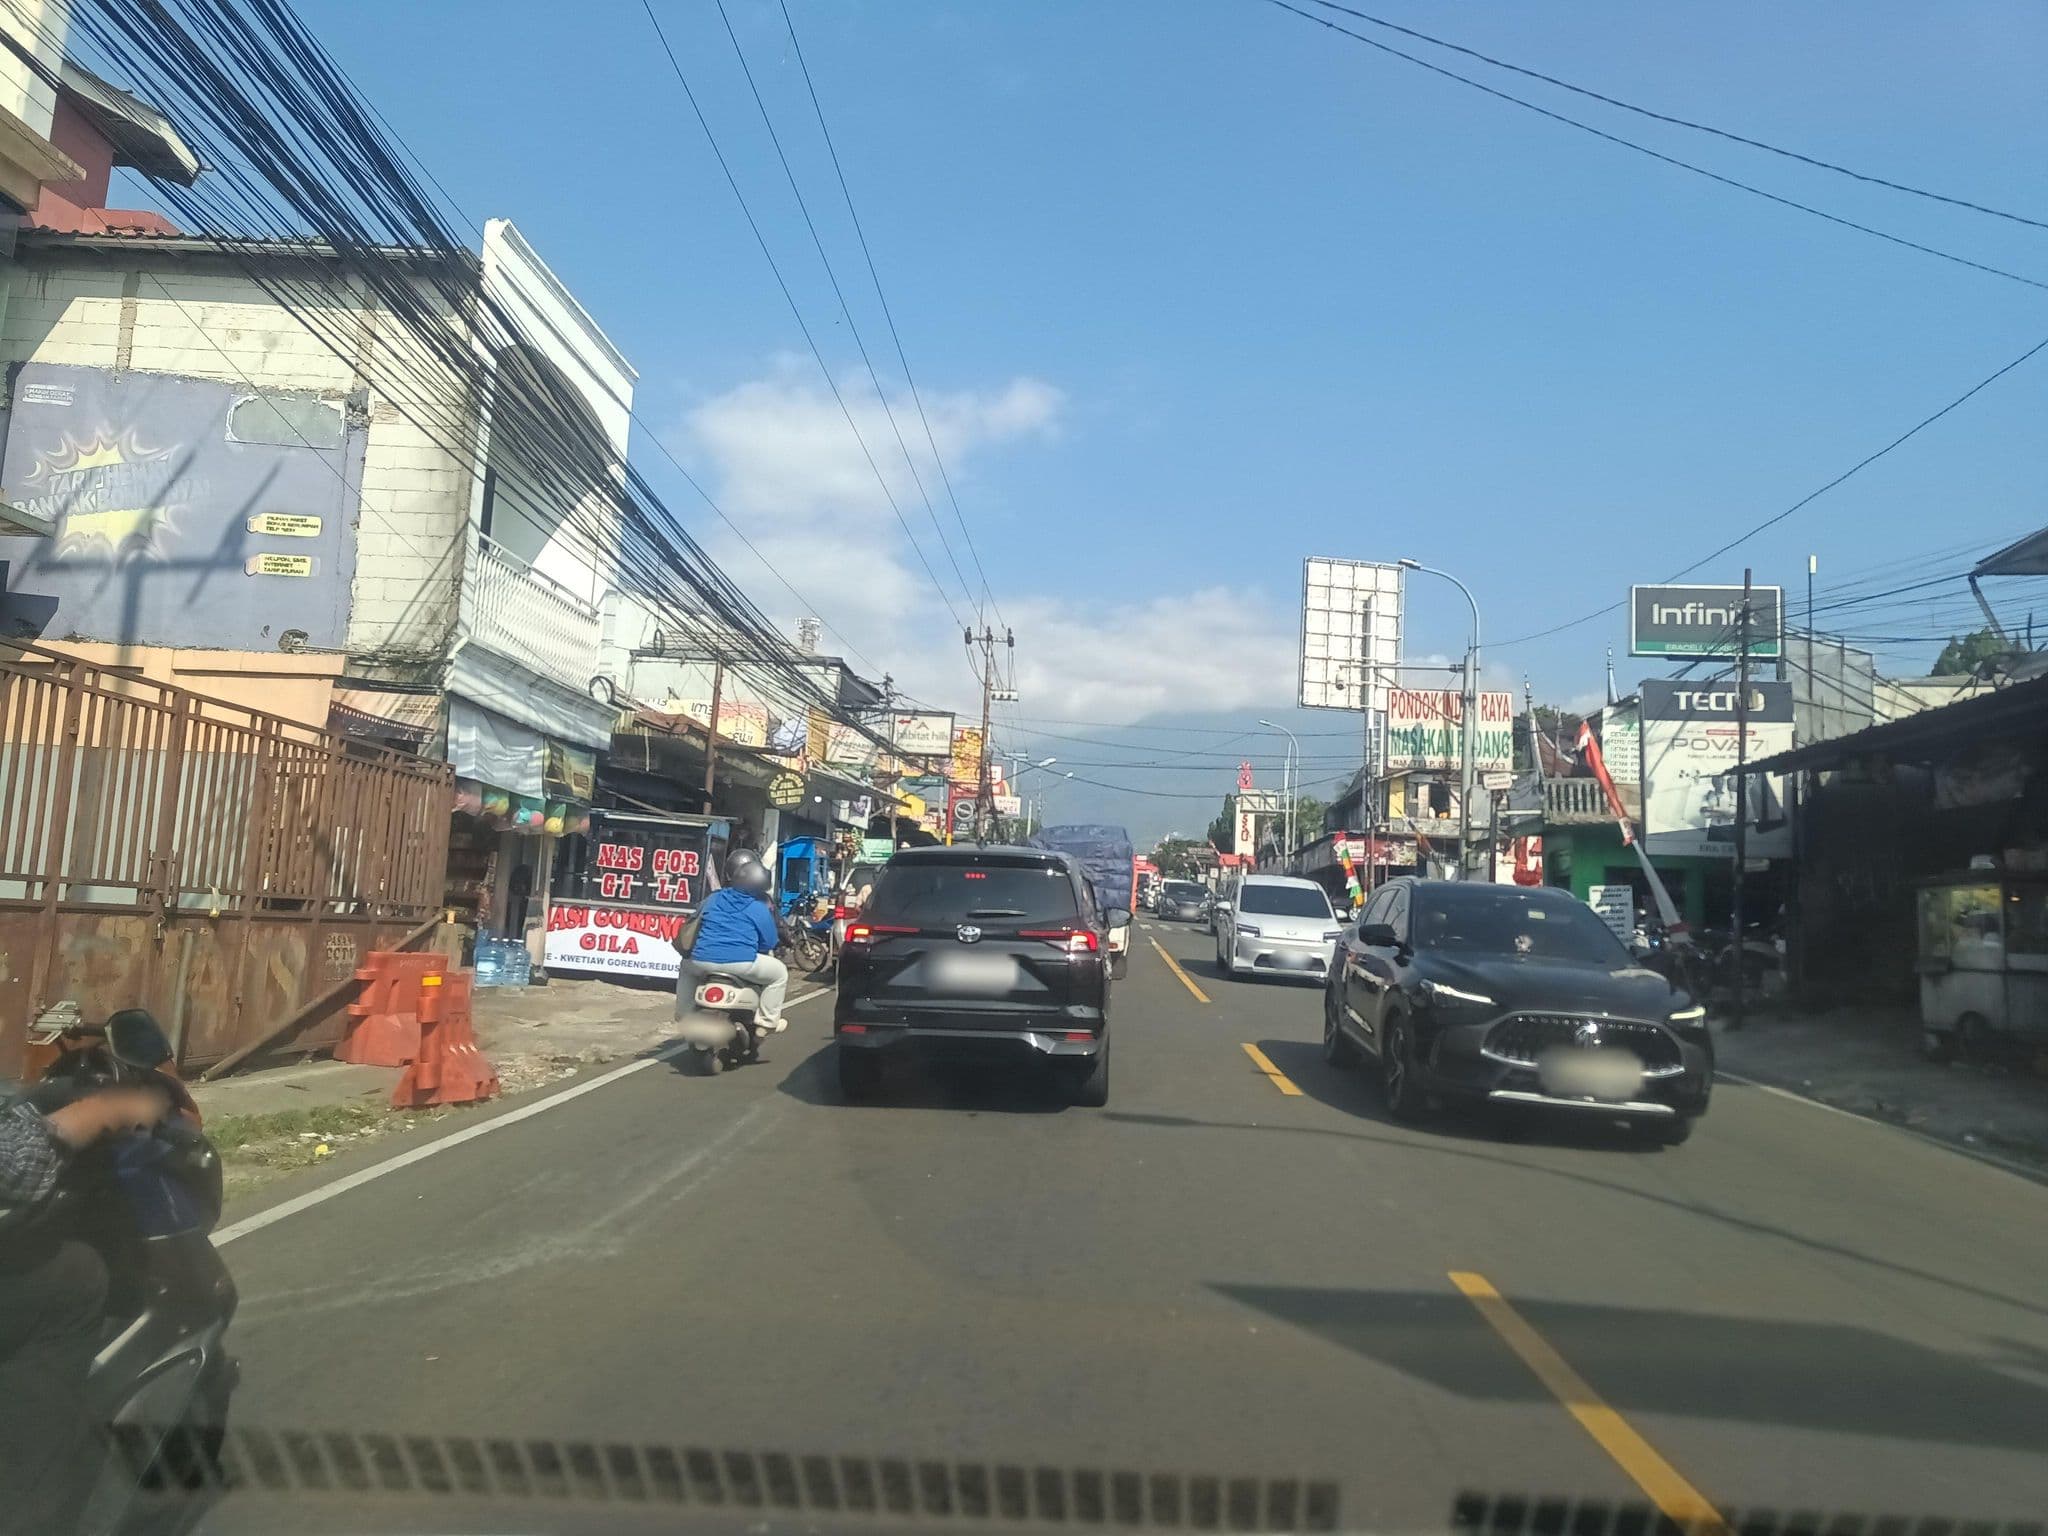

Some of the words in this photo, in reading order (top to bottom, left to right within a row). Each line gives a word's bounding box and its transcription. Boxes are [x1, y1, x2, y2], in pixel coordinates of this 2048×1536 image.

[1391, 691, 1440, 721] PONDOK
[1480, 693, 1511, 722] RAYA
[1391, 727, 1455, 757] MASAKAN
[597, 844, 644, 871] NAS
[653, 849, 699, 876] GOR
[580, 933, 639, 954] GILA
[560, 954, 605, 965] KWETIAW
